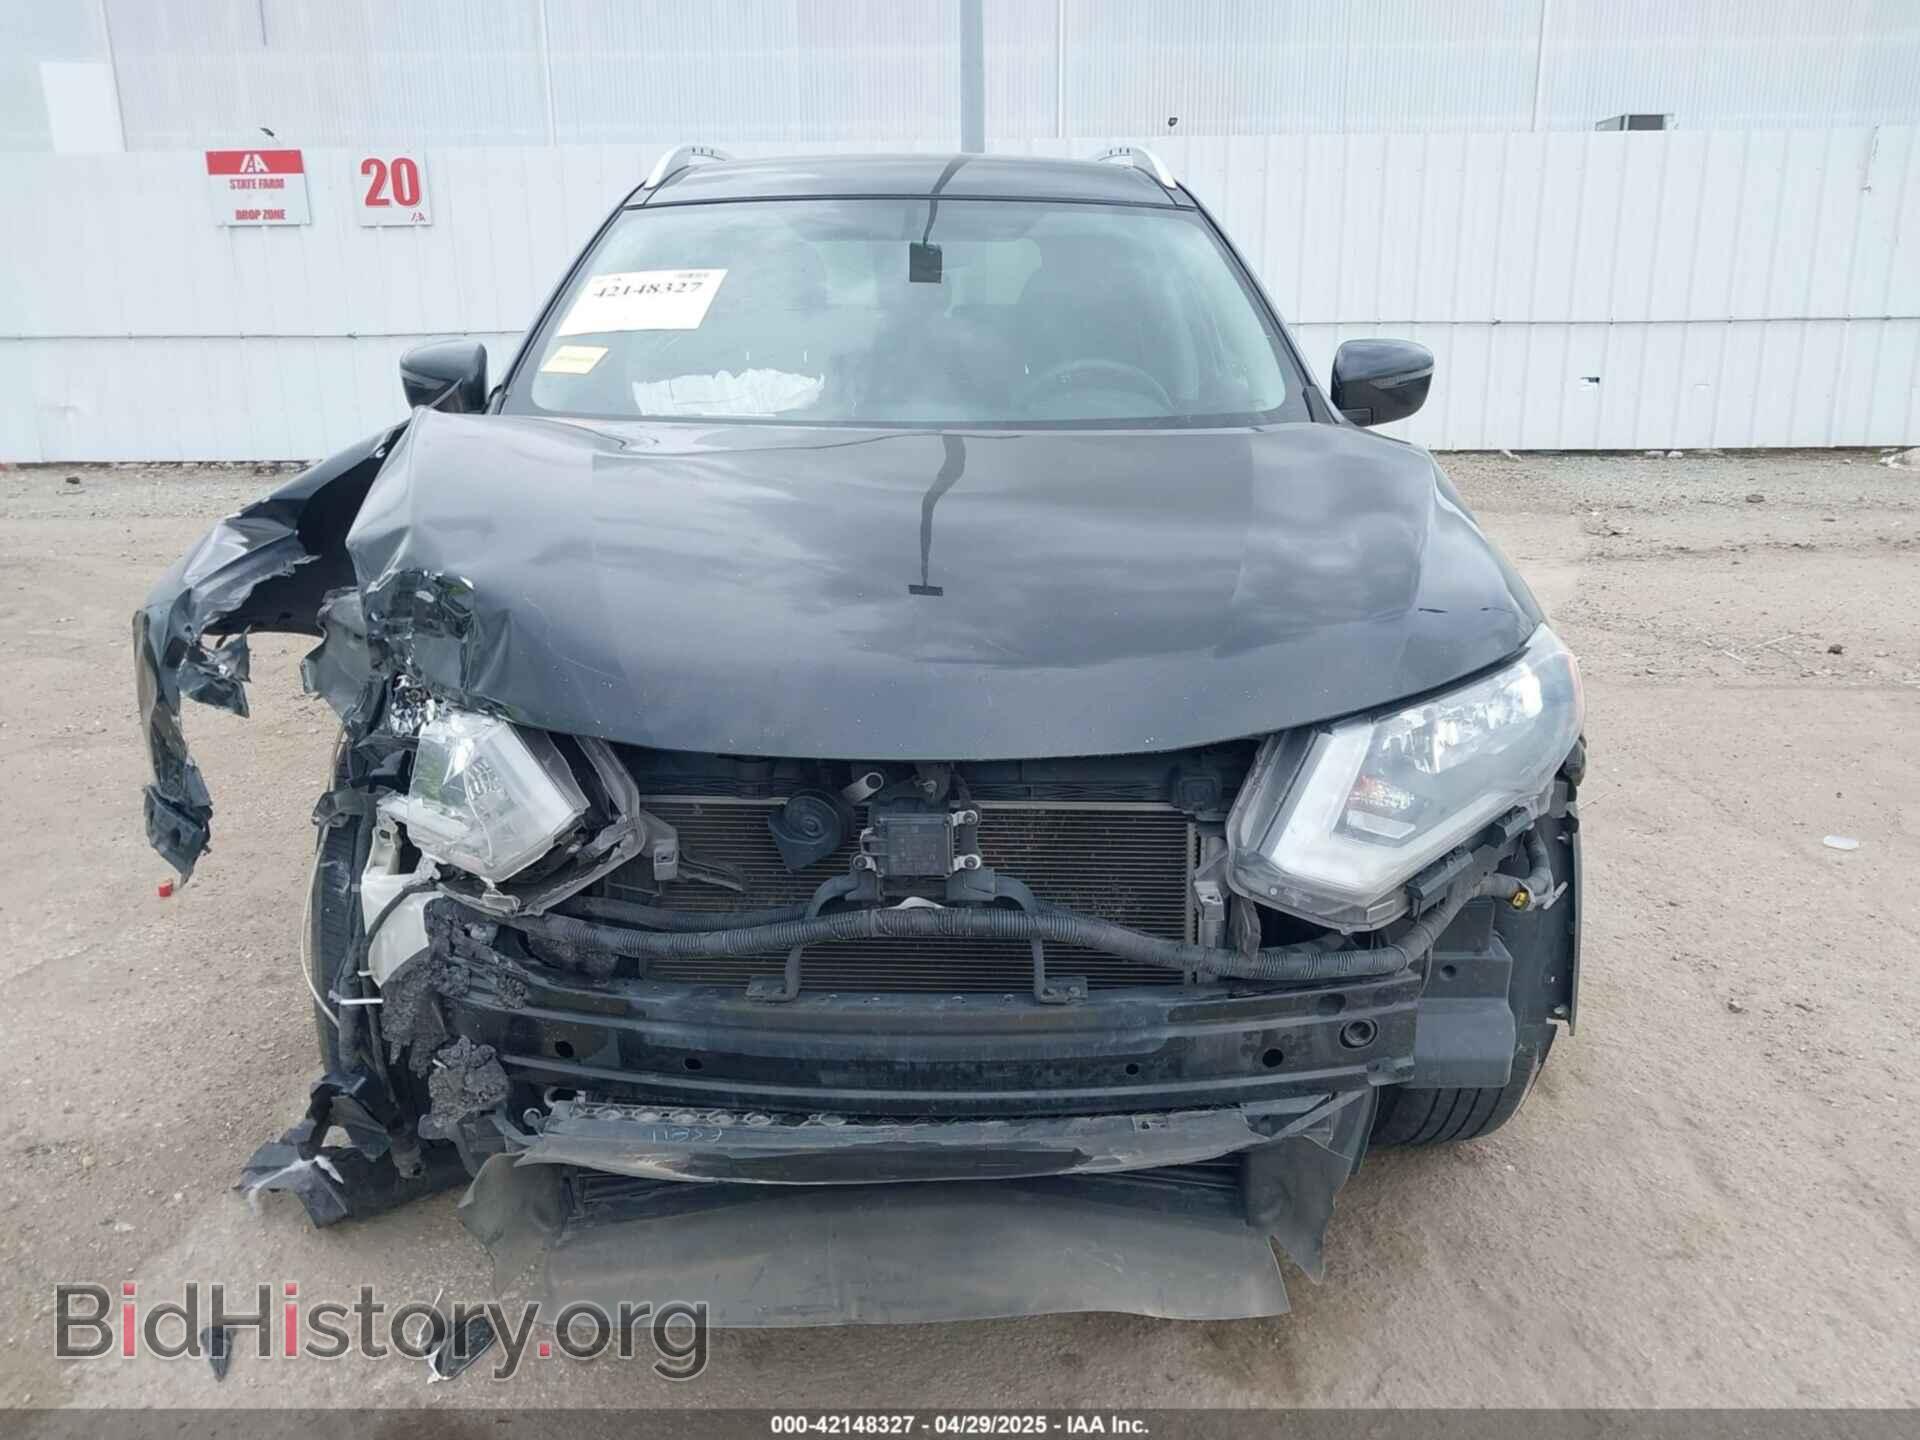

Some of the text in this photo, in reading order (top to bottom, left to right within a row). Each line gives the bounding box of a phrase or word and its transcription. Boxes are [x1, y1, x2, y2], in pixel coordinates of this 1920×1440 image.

[229, 178, 284, 190] STATE FARM
[361, 157, 422, 207] 20
[235, 208, 287, 220] DROP ZONE
[593, 281, 704, 297] 42148327
